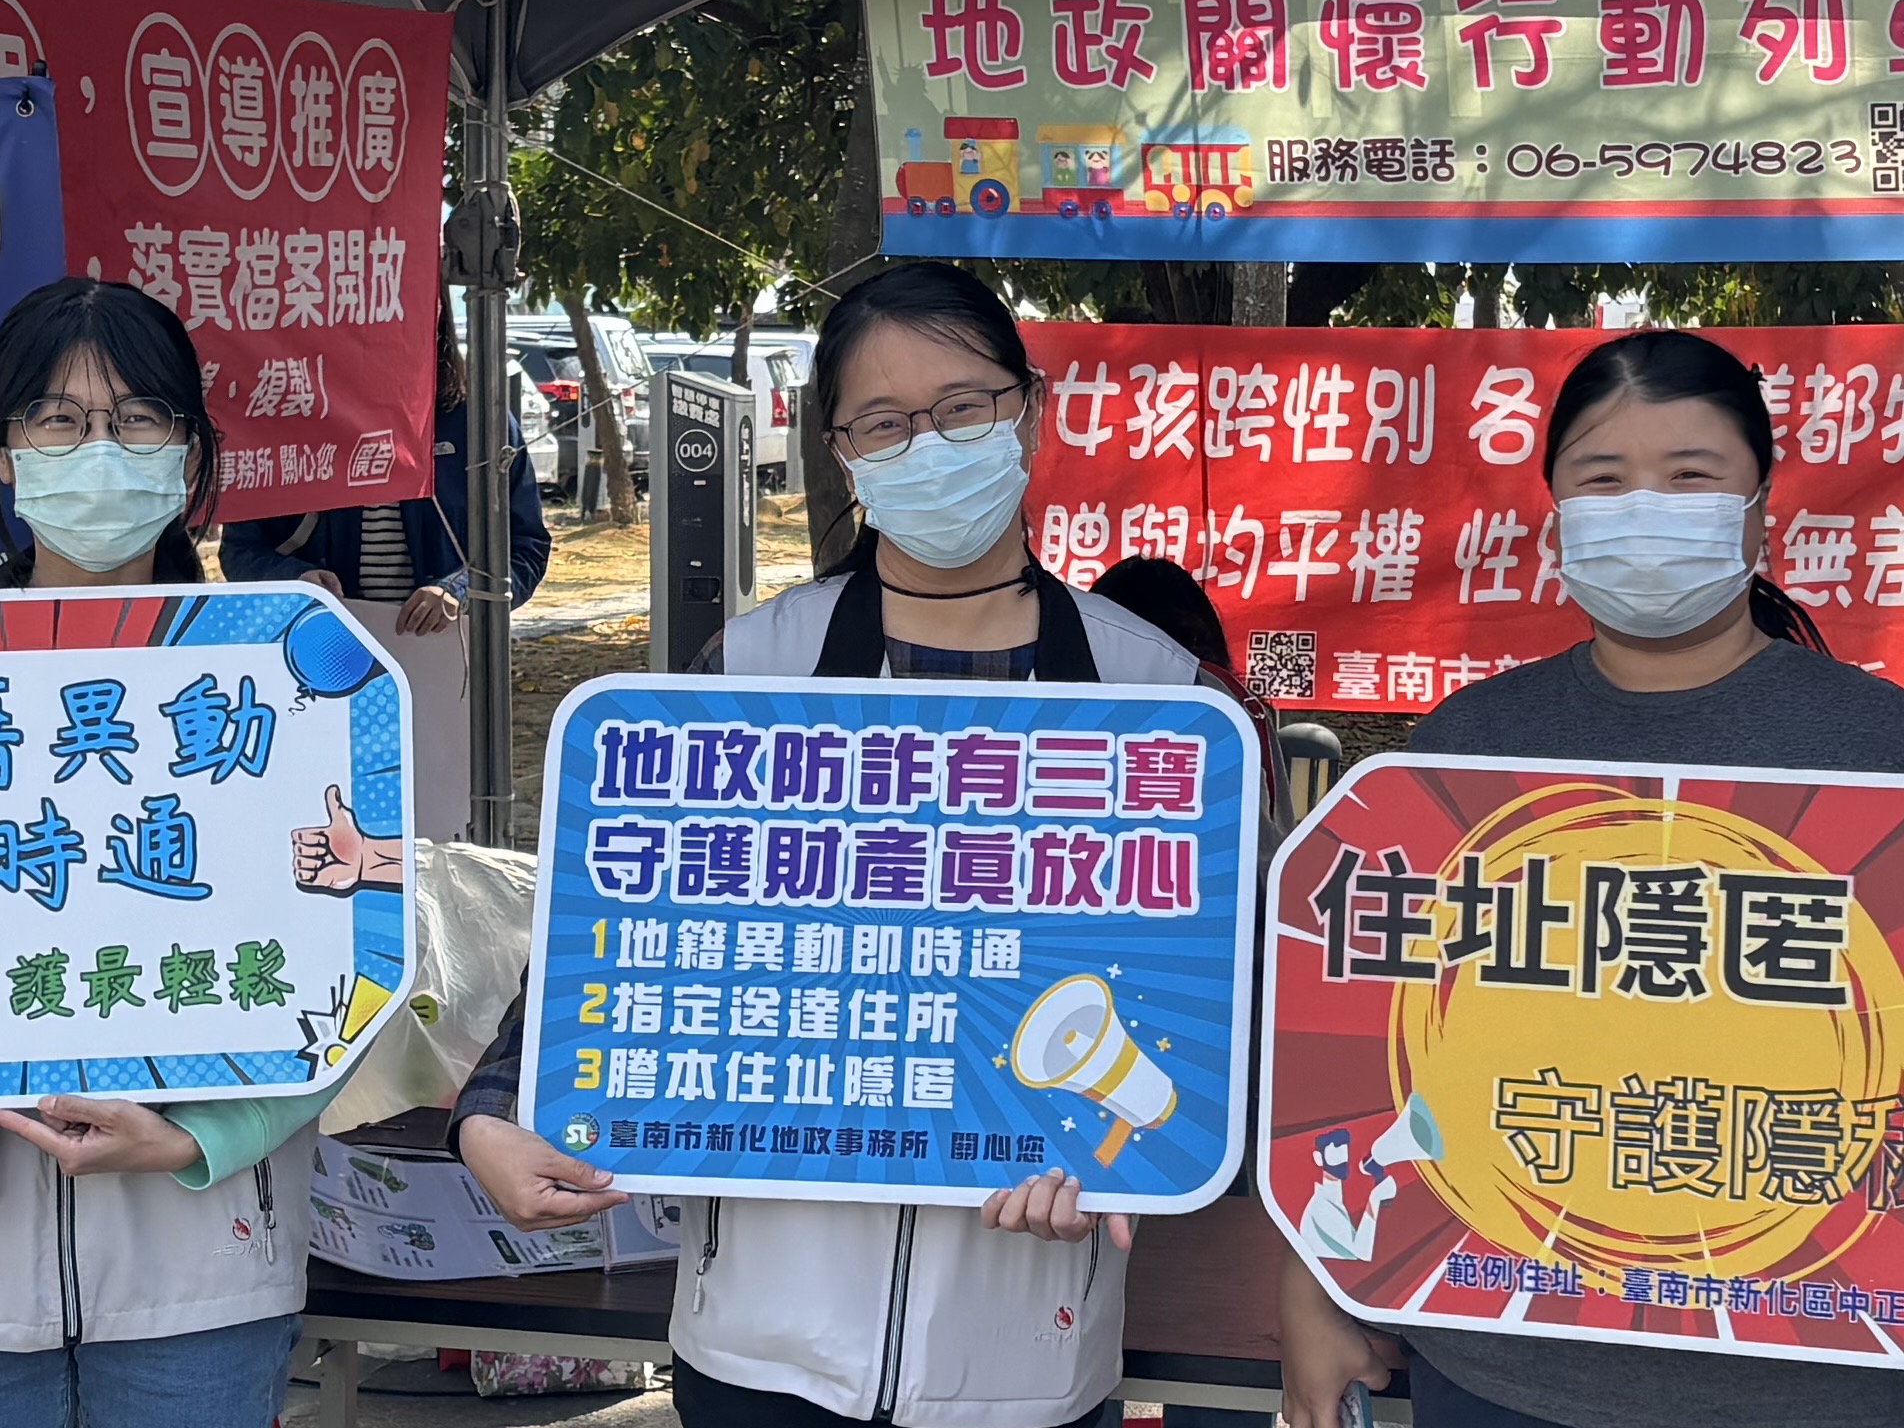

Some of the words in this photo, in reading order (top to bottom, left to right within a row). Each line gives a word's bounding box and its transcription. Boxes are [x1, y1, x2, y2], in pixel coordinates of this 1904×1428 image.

[124, 220, 407, 333] 落實檔案開放
[679, 443, 713, 458] 004
[1052, 361, 1434, 465] 女孩跨性別
[279, 442, 338, 486] 關心您
[1041, 501, 1424, 603] 贈與均平權
[596, 724, 1200, 815] 地政防詐有三寶
[1311, 847, 1851, 1009] 住址隱匿
[608, 1120, 930, 1160] 臺南市新化地政事務所
[949, 1131, 1046, 1165] 關心您
